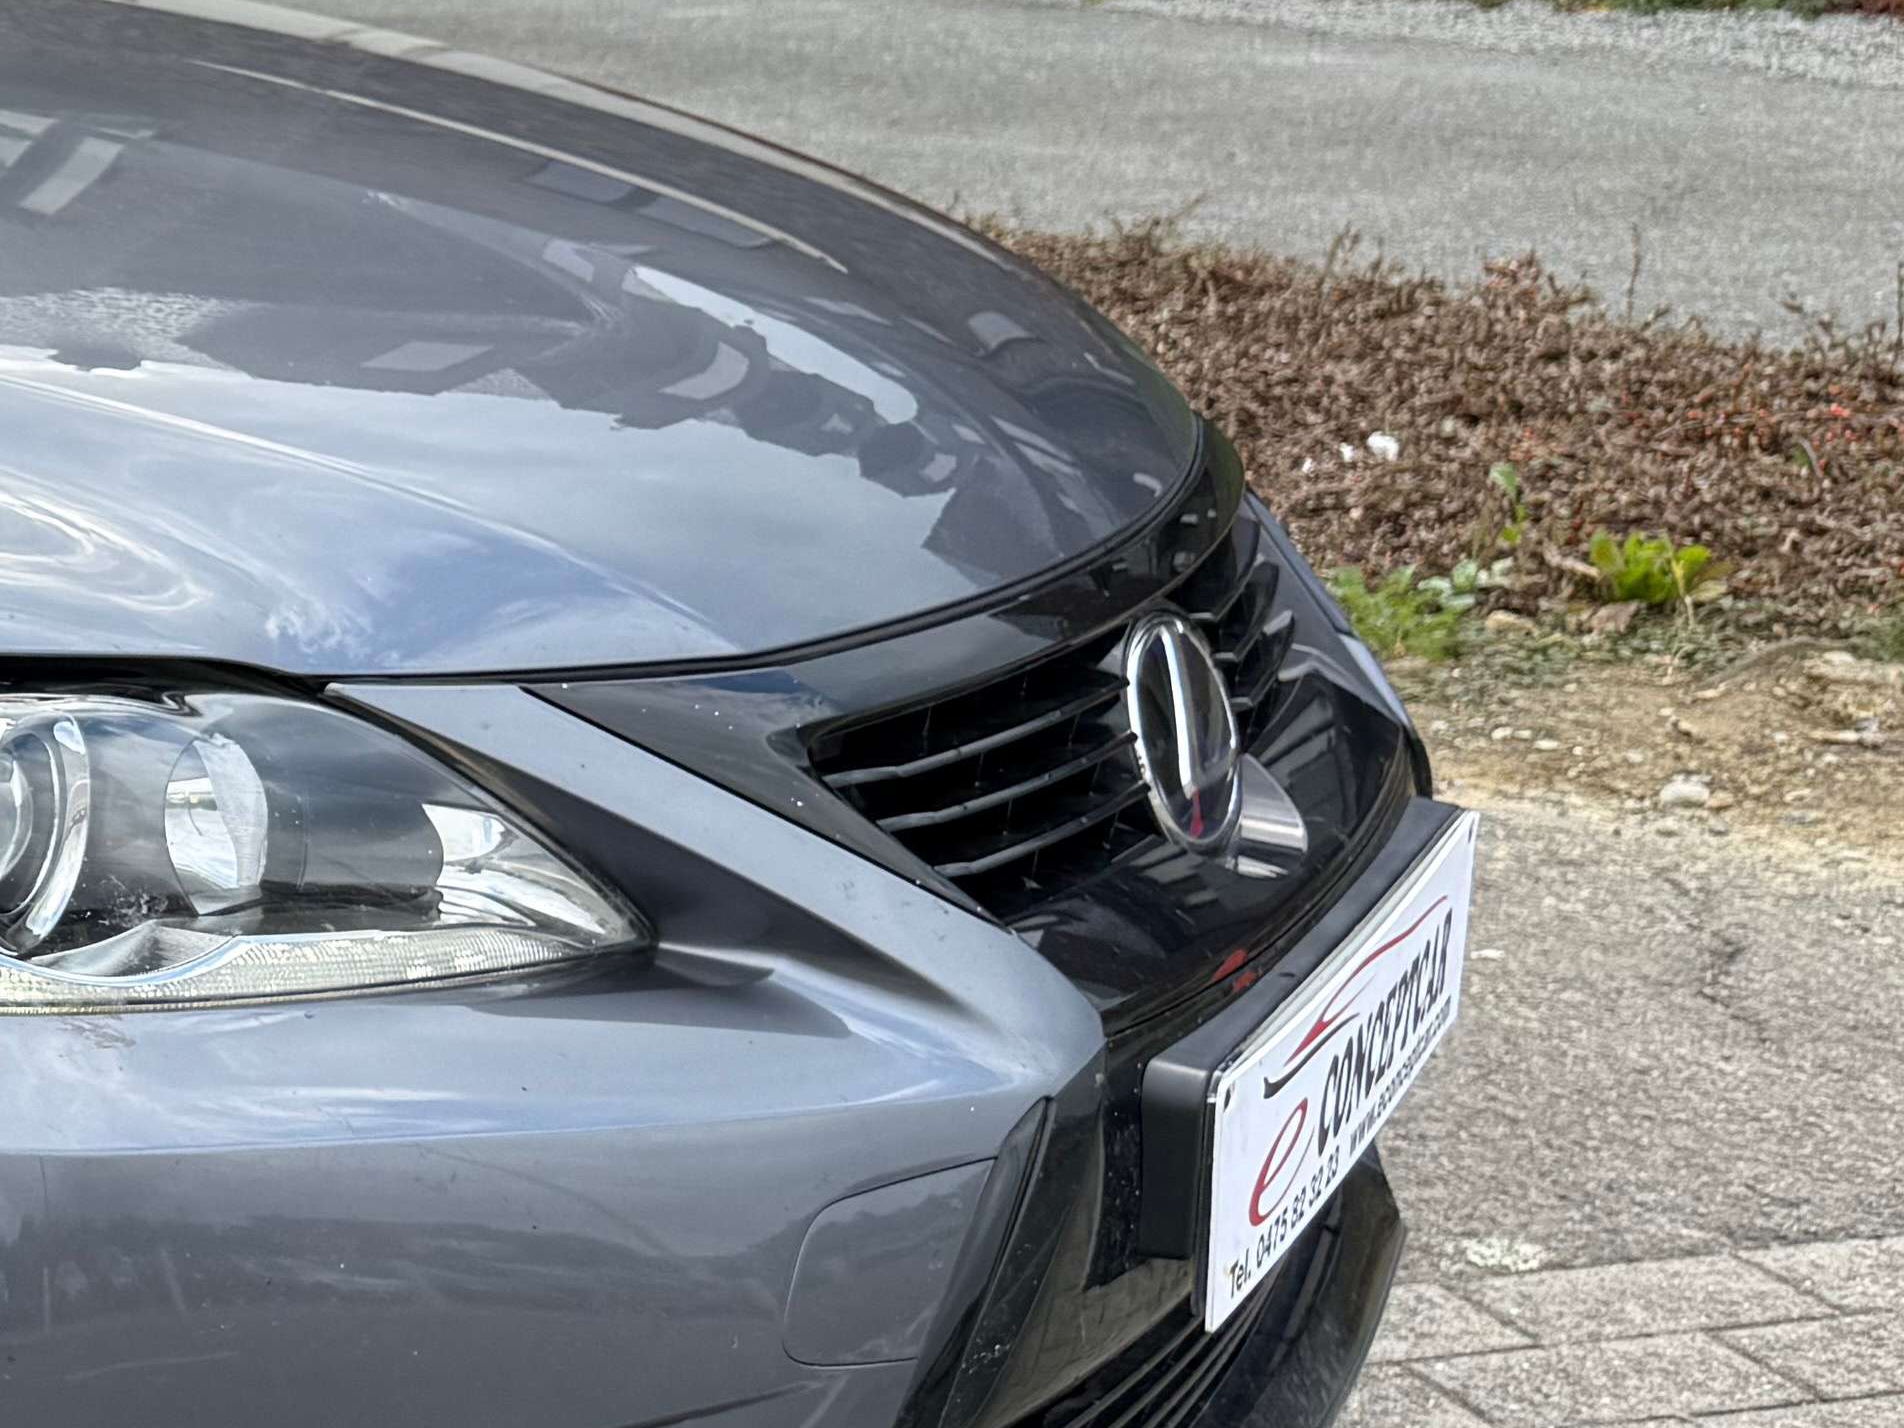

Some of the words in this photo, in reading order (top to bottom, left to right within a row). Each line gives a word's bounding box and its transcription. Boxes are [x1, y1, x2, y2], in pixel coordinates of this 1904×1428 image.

[1230, 1248, 1252, 1298] Tel.
[1256, 1205, 1289, 1269] 0475
[1291, 1185, 1307, 1229] 82
